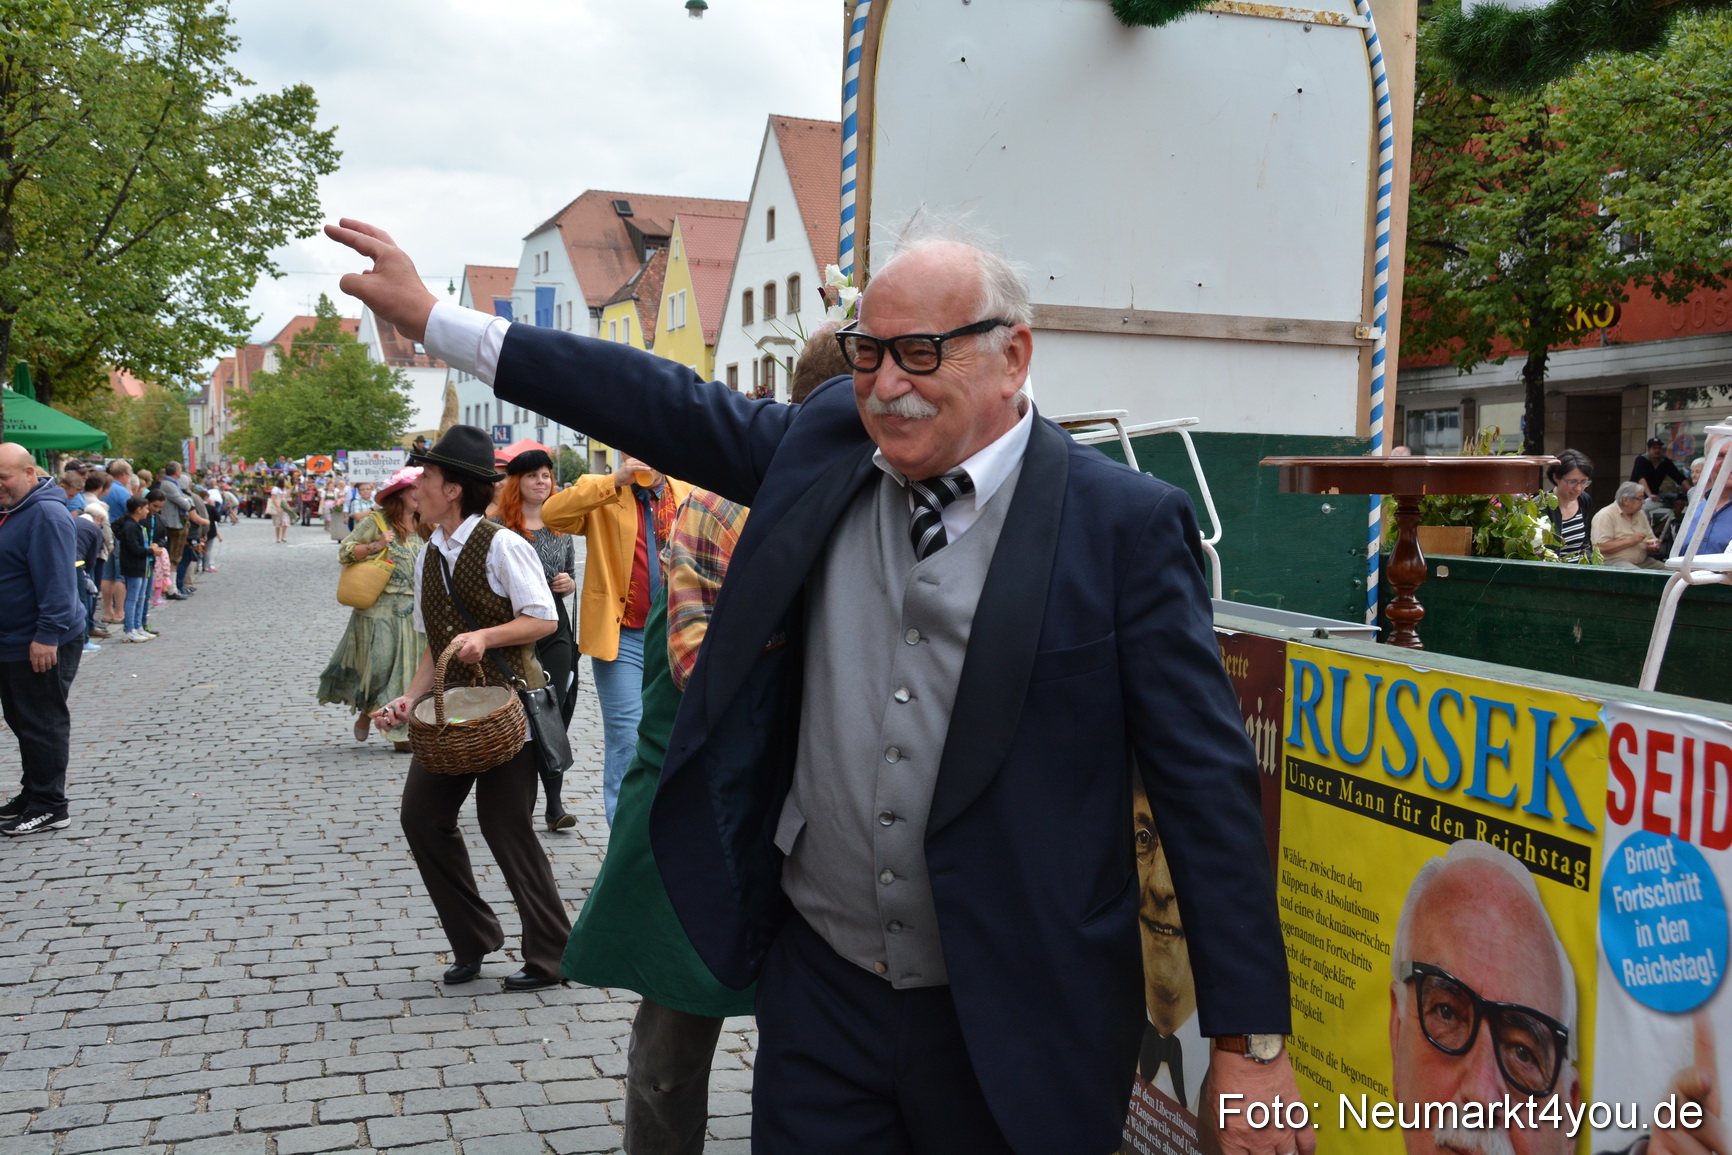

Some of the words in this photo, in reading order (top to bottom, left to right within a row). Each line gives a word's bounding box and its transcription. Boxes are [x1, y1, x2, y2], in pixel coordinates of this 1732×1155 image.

[1285, 658, 1598, 832] RUSSEK
[1606, 722, 1732, 851] SEID
[1288, 762, 1332, 796] Unser
[1339, 777, 1385, 813] Mann
[1393, 793, 1422, 825] für
[1430, 805, 1465, 840] den
[1476, 819, 1587, 889] Reichstag
[1283, 846, 1308, 873] Wähler,
[1309, 861, 1346, 886] zwischen
[1347, 872, 1363, 893] den
[1624, 838, 1676, 875] Bringt
[1281, 870, 1310, 895] Klippen
[1311, 882, 1323, 900] des
[1324, 889, 1380, 925] Absolutismus
[1612, 872, 1703, 914] Fortschritt
[1280, 896, 1293, 911] und
[1294, 901, 1314, 920] eines
[1316, 909, 1391, 956] duckmäuserischen
[1635, 919, 1654, 948] in
[1656, 916, 1690, 946] den
[1285, 944, 1299, 961] ebt
[1300, 949, 1312, 968] der
[1313, 960, 1357, 990] aufgeklärte
[1326, 938, 1372, 973] Fortschritts
[1622, 948, 1718, 987] Reichstag!
[1310, 979, 1323, 999] frei
[1324, 990, 1345, 1011] nach
[1295, 1057, 1335, 1093] fortsetzen.
[1297, 1034, 1309, 1053] Sie
[1310, 1044, 1324, 1062] uns
[1326, 1051, 1338, 1070] die
[1340, 1057, 1389, 1098] begonnene
[1130, 1115, 1161, 1150] Wahlkreis
[1136, 1101, 1171, 1138] Langeweile
[1171, 1130, 1185, 1149] und
[1142, 1088, 1155, 1109] dem
[1156, 1099, 1199, 1143] Liberalismus,
